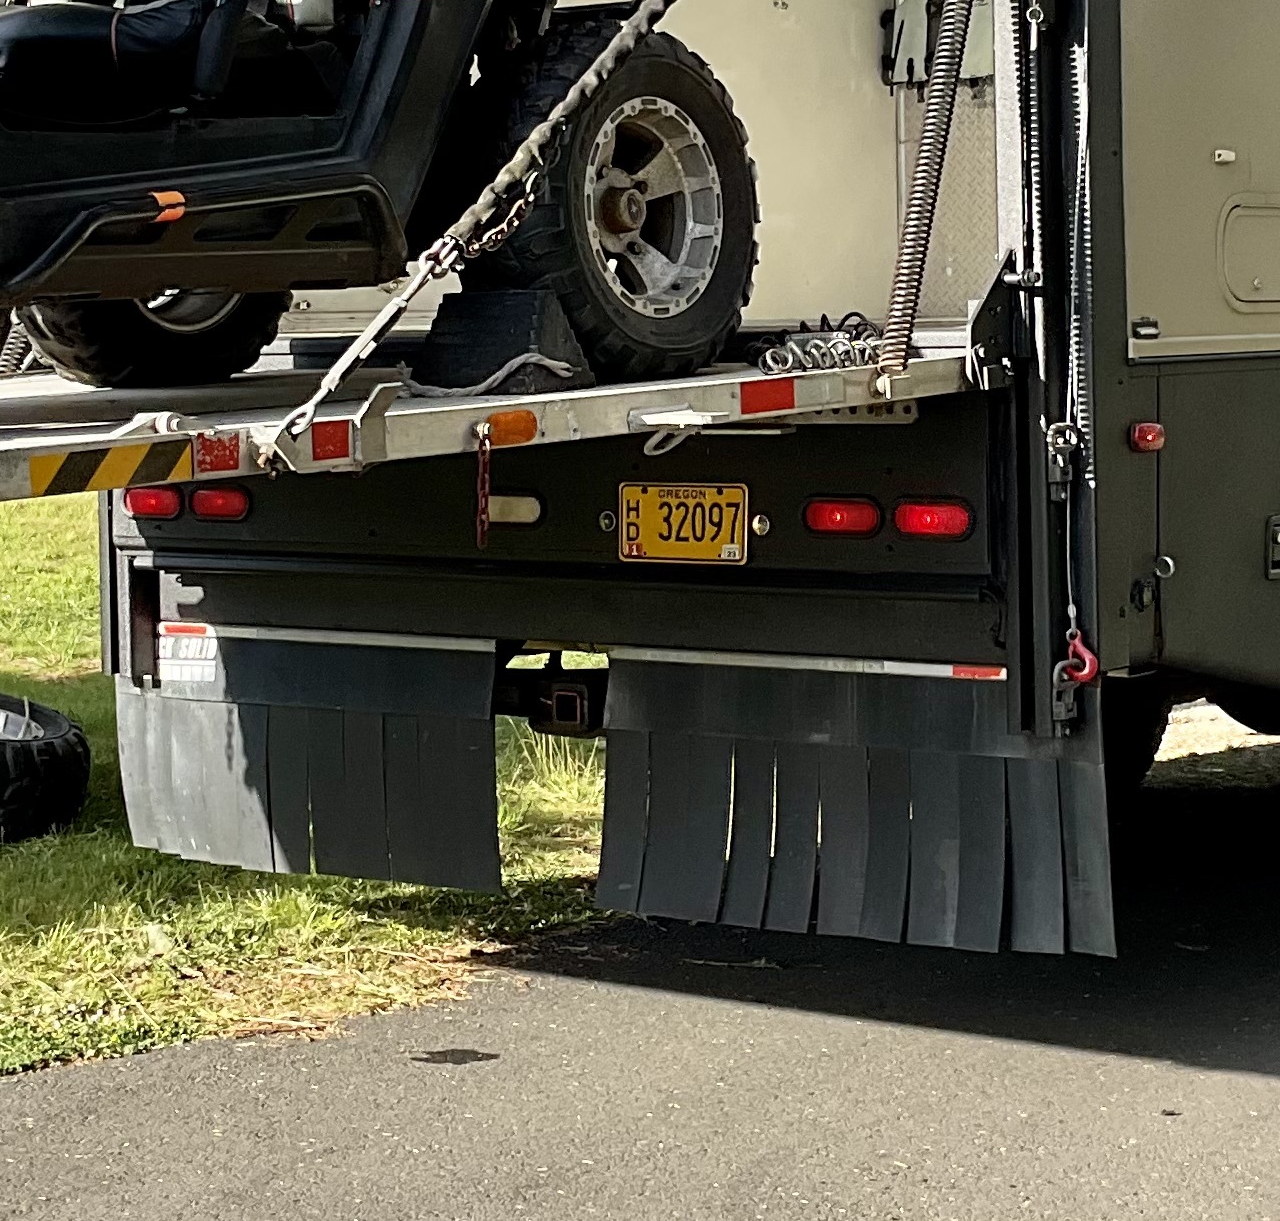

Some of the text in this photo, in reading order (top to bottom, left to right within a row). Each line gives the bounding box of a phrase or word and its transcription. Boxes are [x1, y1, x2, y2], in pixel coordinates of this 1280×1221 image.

[658, 489, 706, 499] OREGON
[658, 501, 741, 544] 32097
[159, 636, 218, 659] CK SOLID
